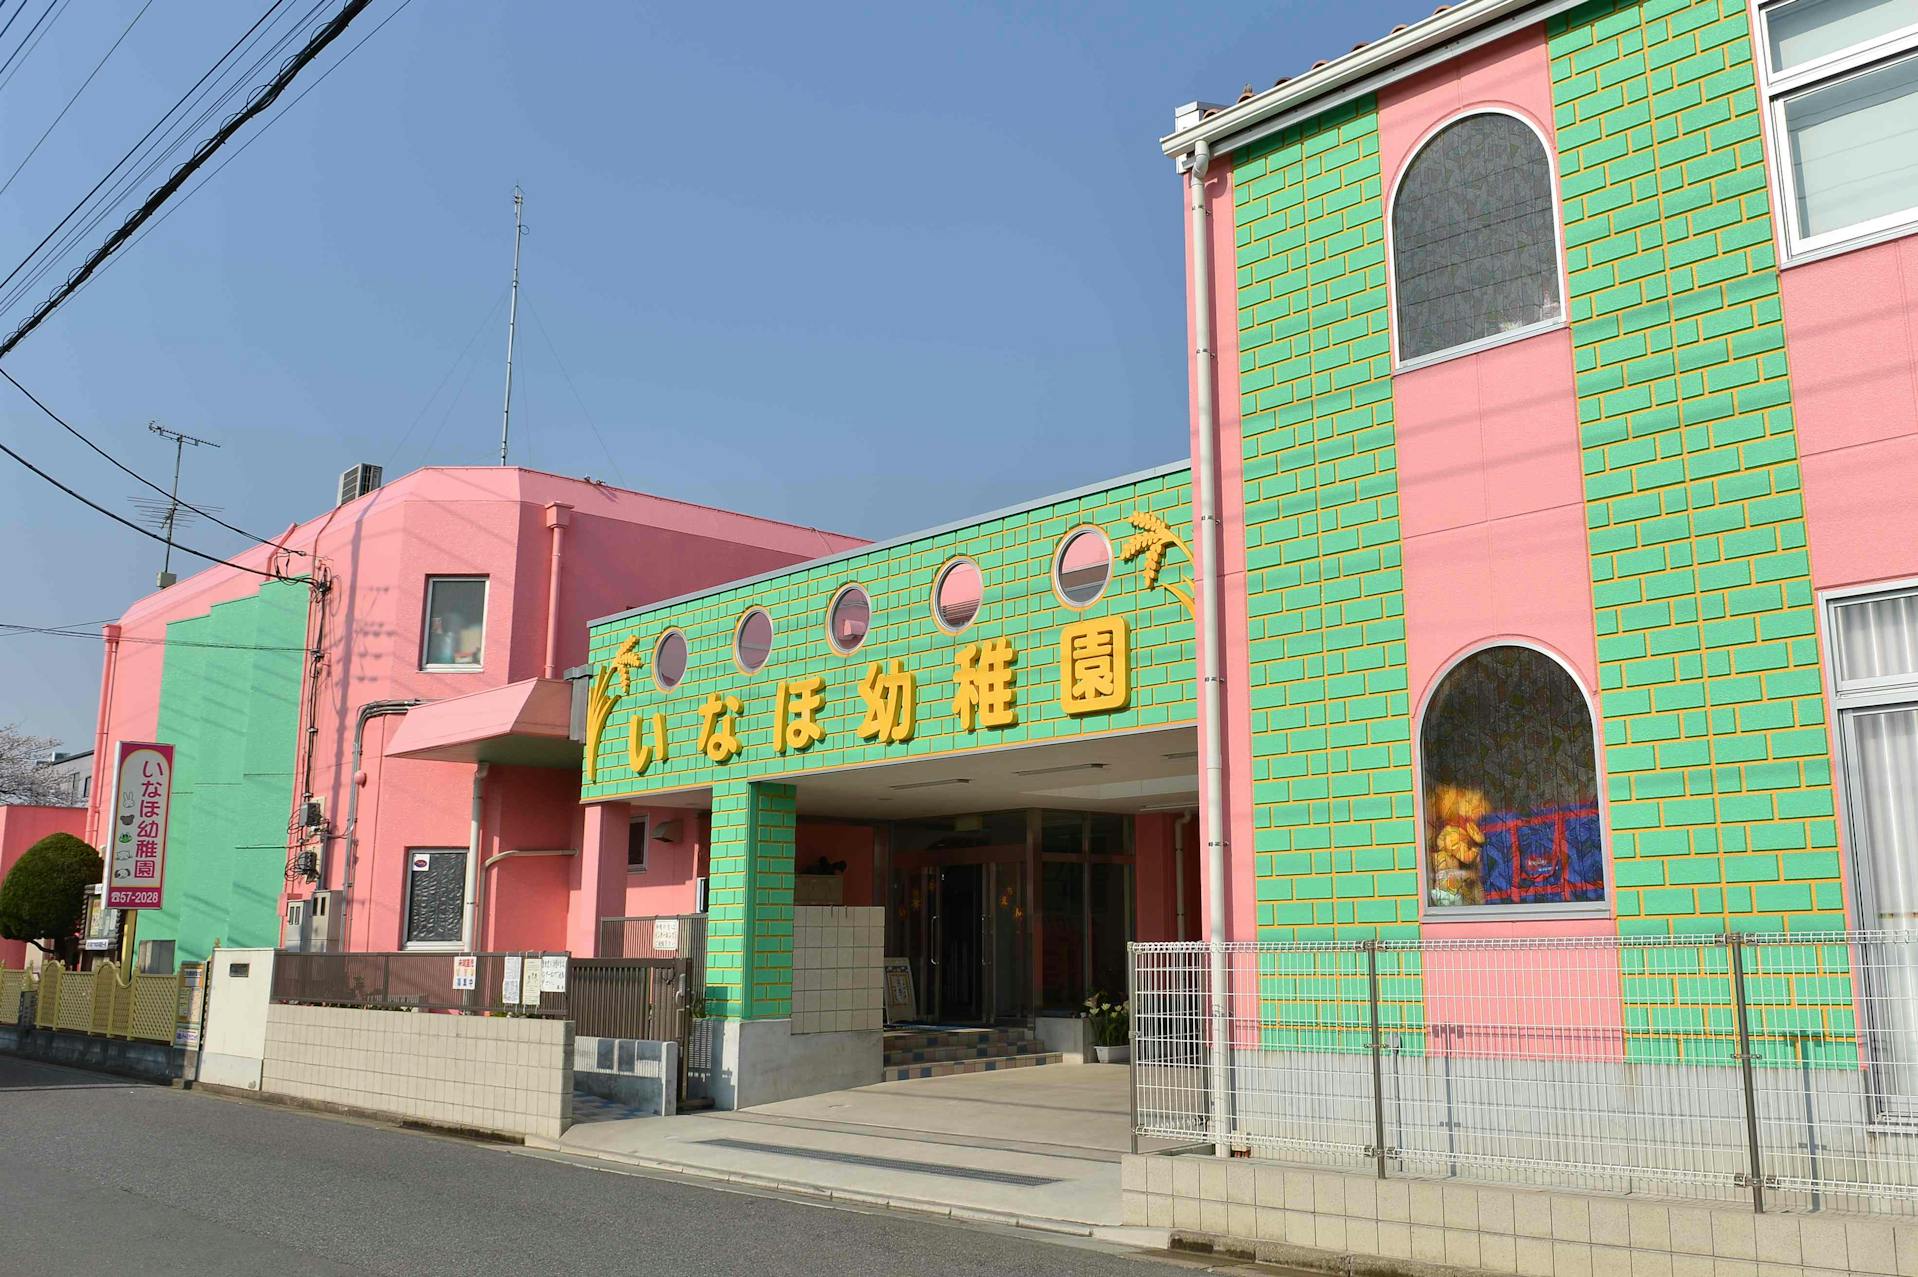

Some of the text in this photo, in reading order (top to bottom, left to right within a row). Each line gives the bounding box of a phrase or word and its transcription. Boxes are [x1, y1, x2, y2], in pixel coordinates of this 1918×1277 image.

[629, 616, 1131, 774] いなほ幼稚園
[134, 760, 164, 878] いなほ幼稚園
[120, 892, 159, 903] 57-2028
